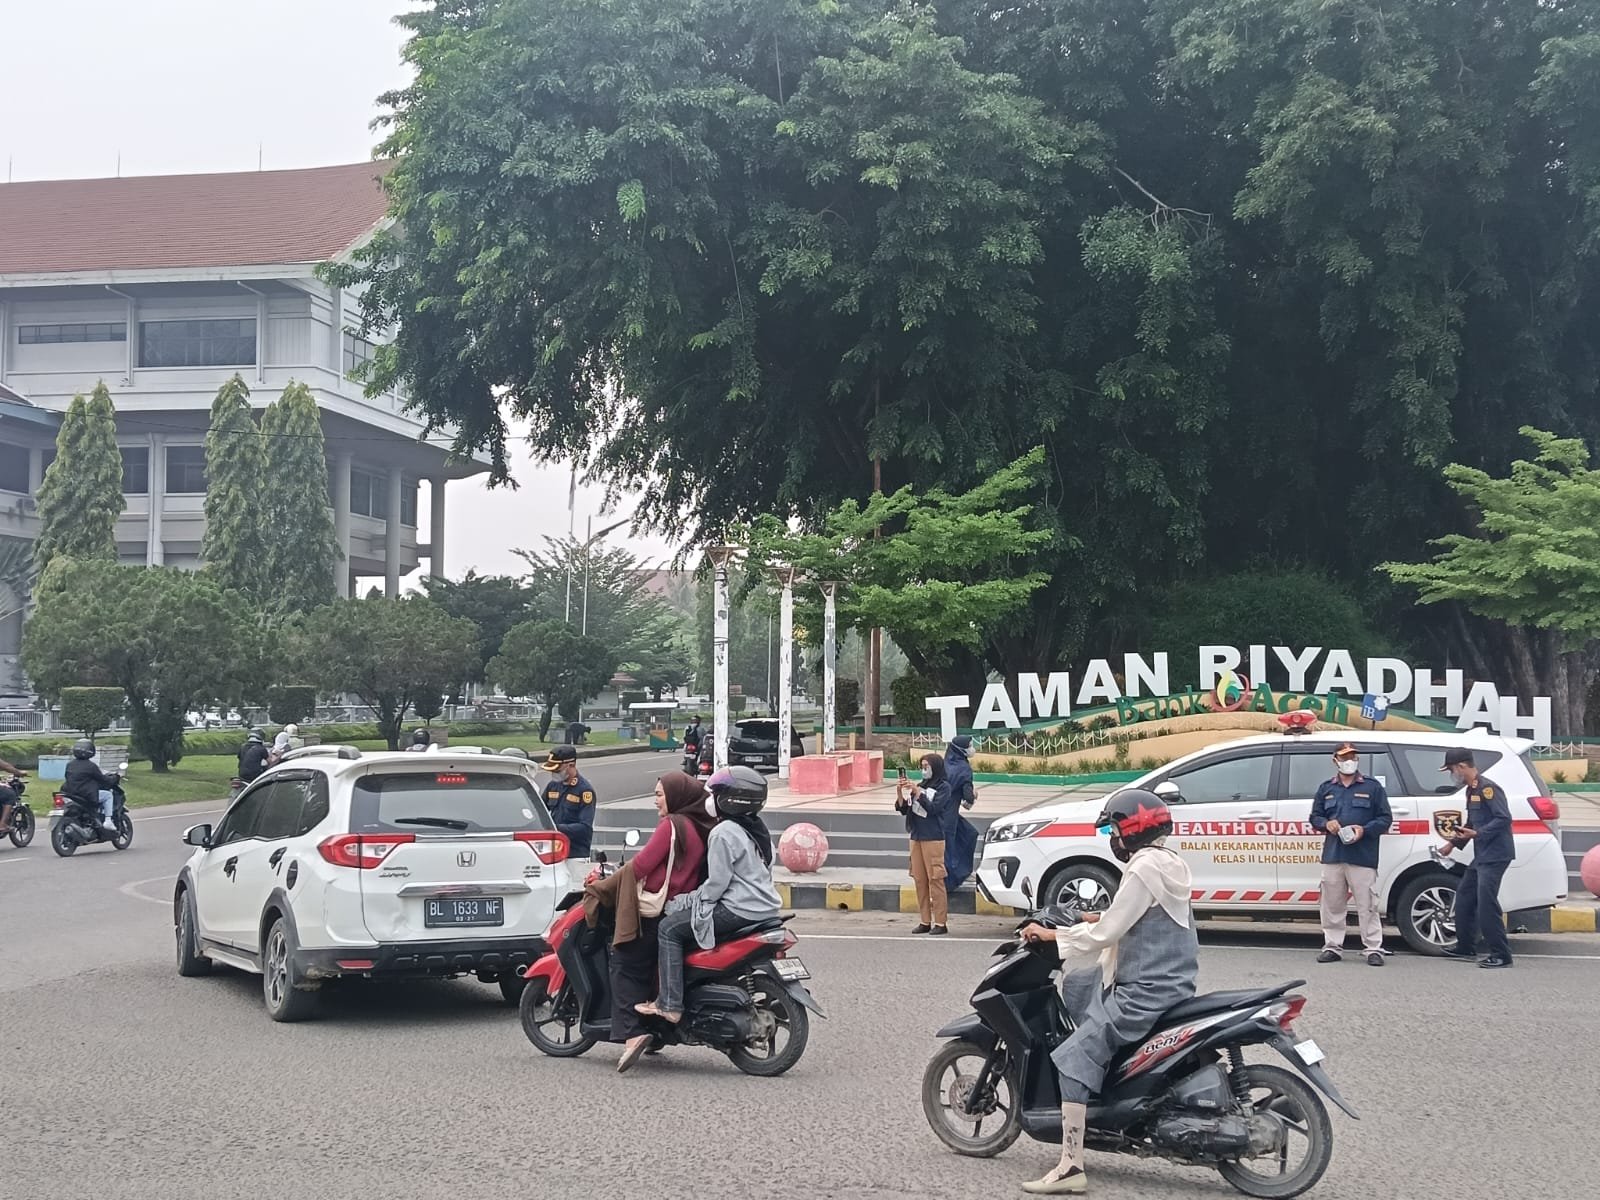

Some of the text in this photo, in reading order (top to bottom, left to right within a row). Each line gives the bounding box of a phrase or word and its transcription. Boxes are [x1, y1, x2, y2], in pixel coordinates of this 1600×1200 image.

[925, 644, 1552, 747] TAMAN RIYADHAH
[1115, 682, 1349, 726] Bank Aceh
[1363, 705, 1375, 719] iB
[1180, 841, 1323, 852] BALAI KEKARANTINAAN KE
[1213, 854, 1322, 864] KELAS II LHOKSEUMA
[430, 900, 499, 916] BL 1633 NF
